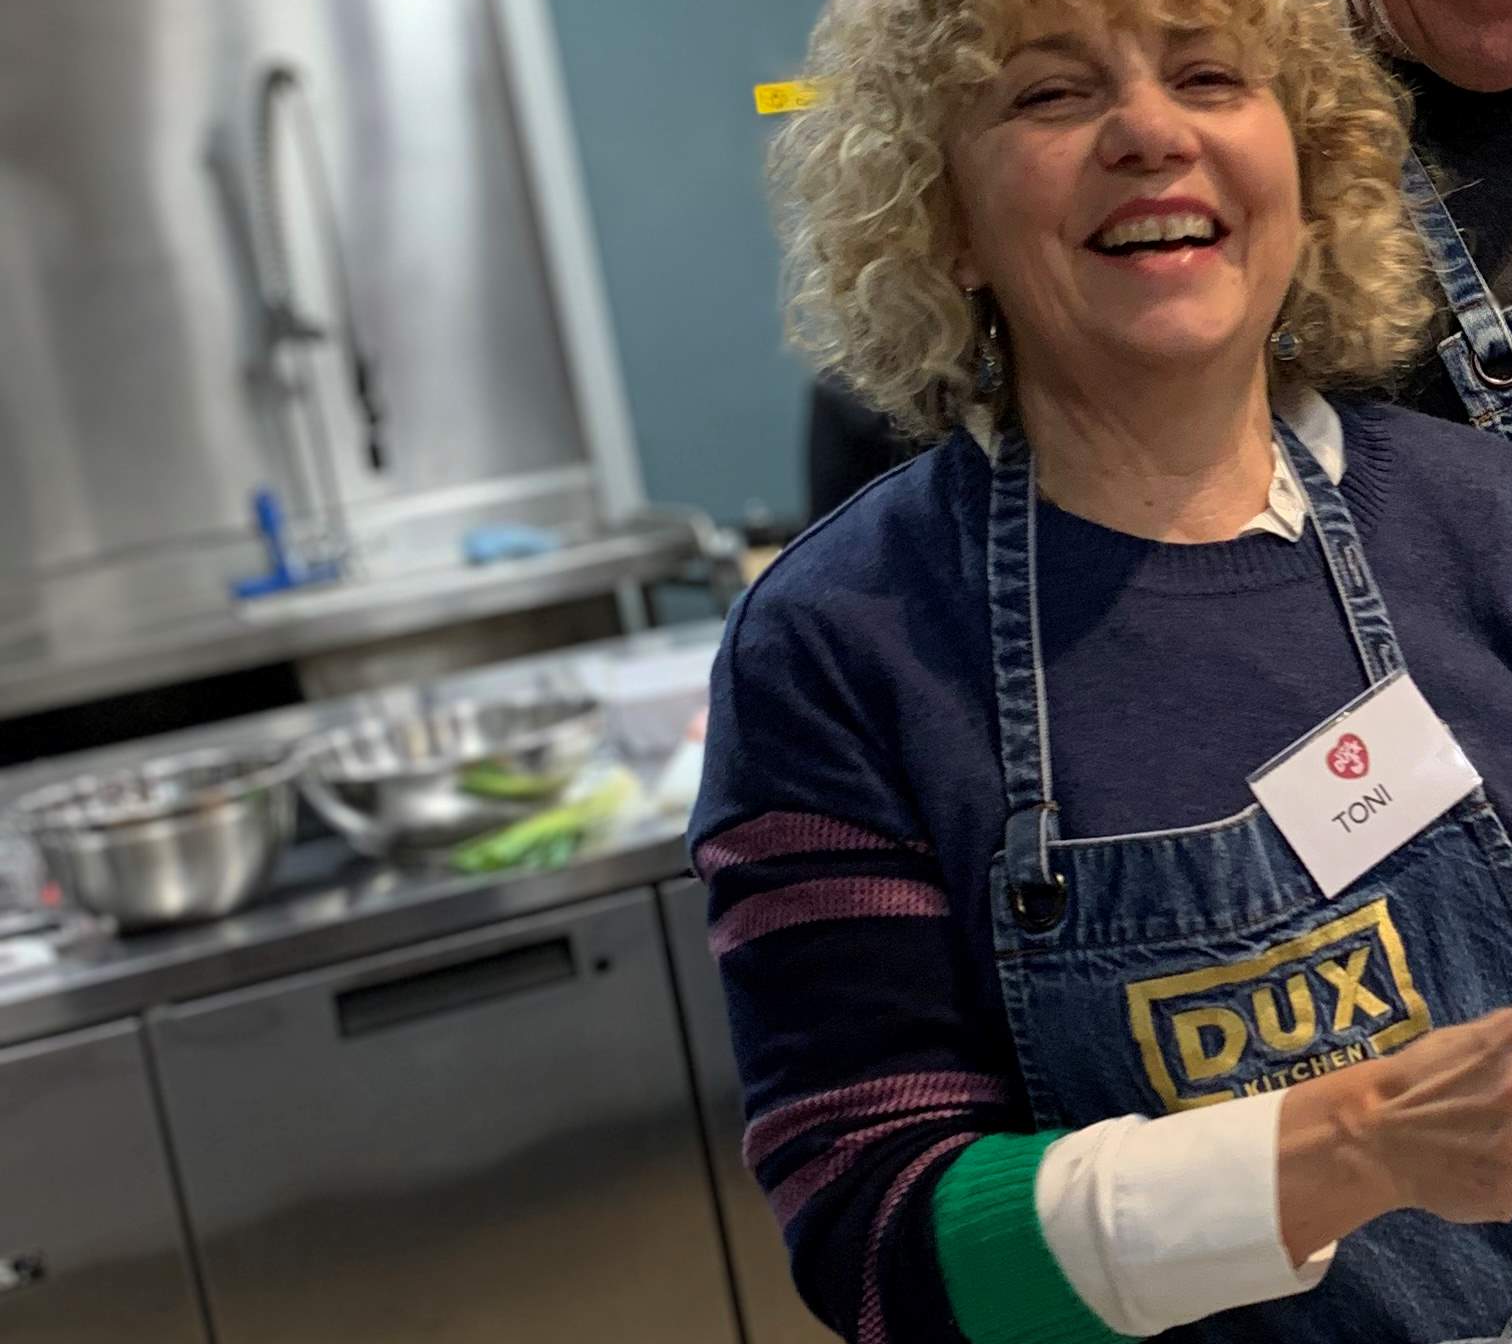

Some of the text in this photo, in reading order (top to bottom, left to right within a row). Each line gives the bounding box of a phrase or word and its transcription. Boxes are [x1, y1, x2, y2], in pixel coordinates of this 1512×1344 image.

[1331, 783, 1394, 834] TONI
[1173, 950, 1390, 1080] DUX
[1243, 1042, 1364, 1097] KITCHEN
